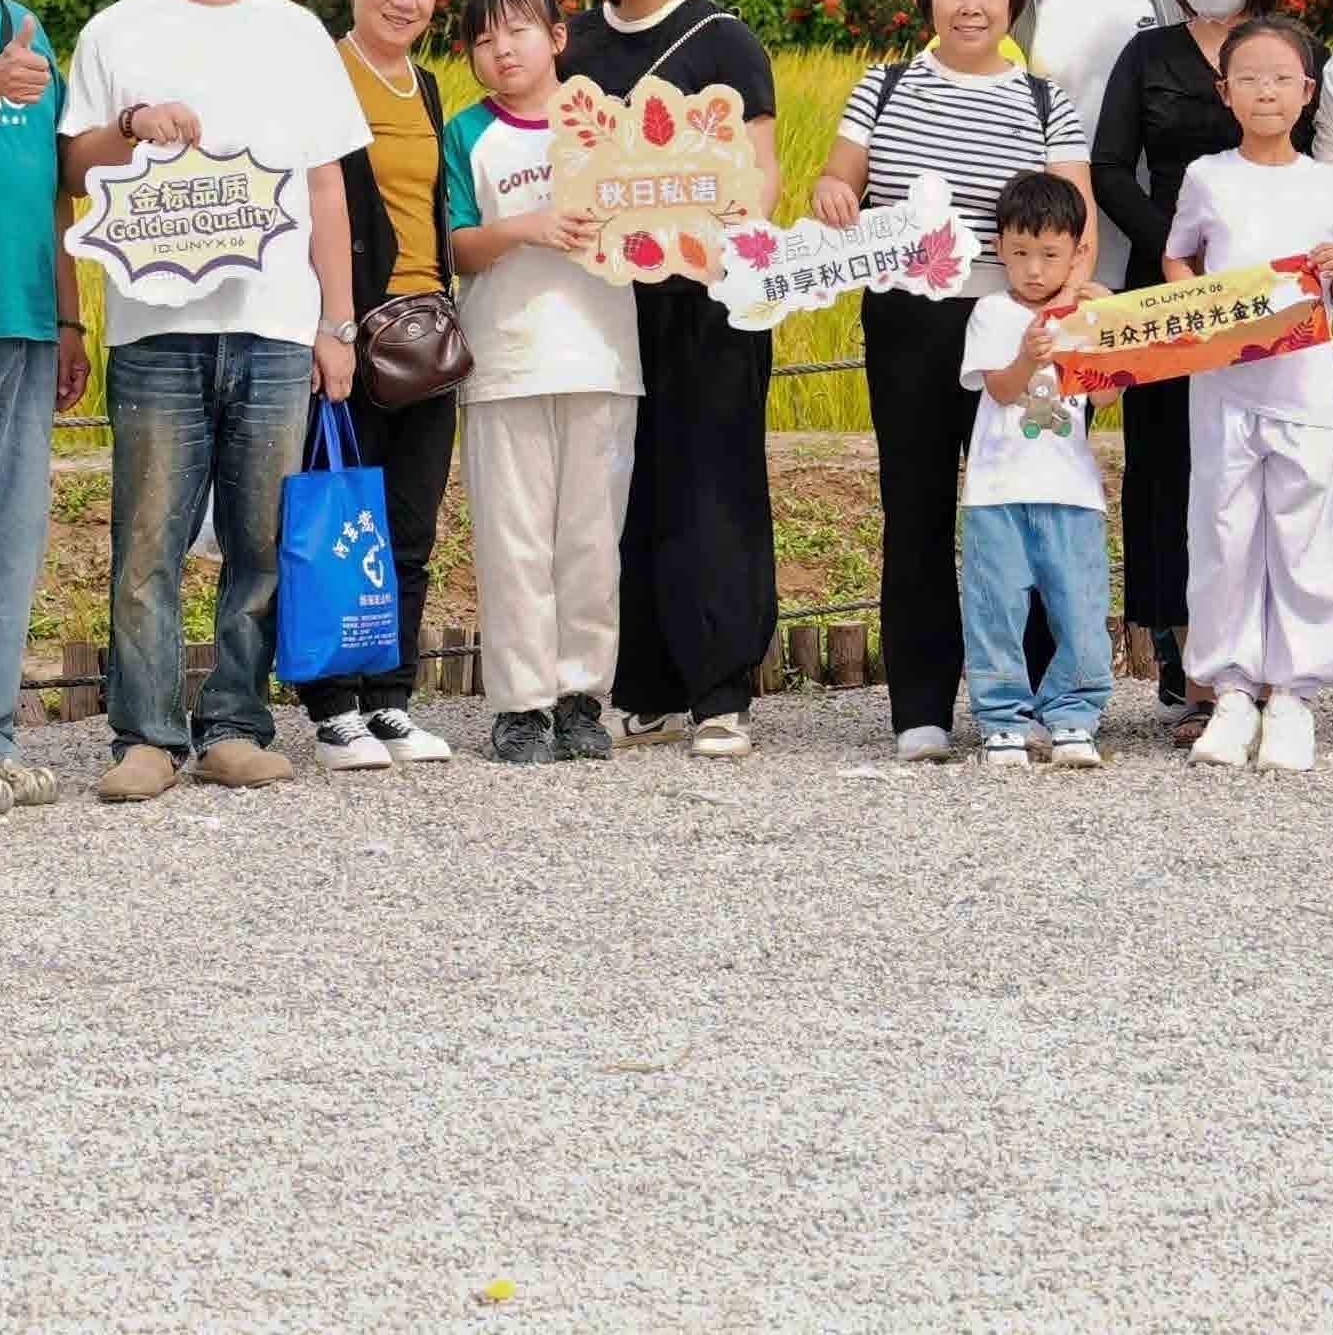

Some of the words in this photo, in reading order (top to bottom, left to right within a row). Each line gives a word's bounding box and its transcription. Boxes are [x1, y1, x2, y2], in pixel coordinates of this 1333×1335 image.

[130, 173, 249, 216] 金标品质
[596, 173, 718, 209] 秋日私语
[106, 215, 190, 244] Golden
[192, 205, 278, 237] Quality
[762, 240, 928, 303] 静享秋日时光
[1099, 294, 1276, 348] 与众开启拾光金秋
